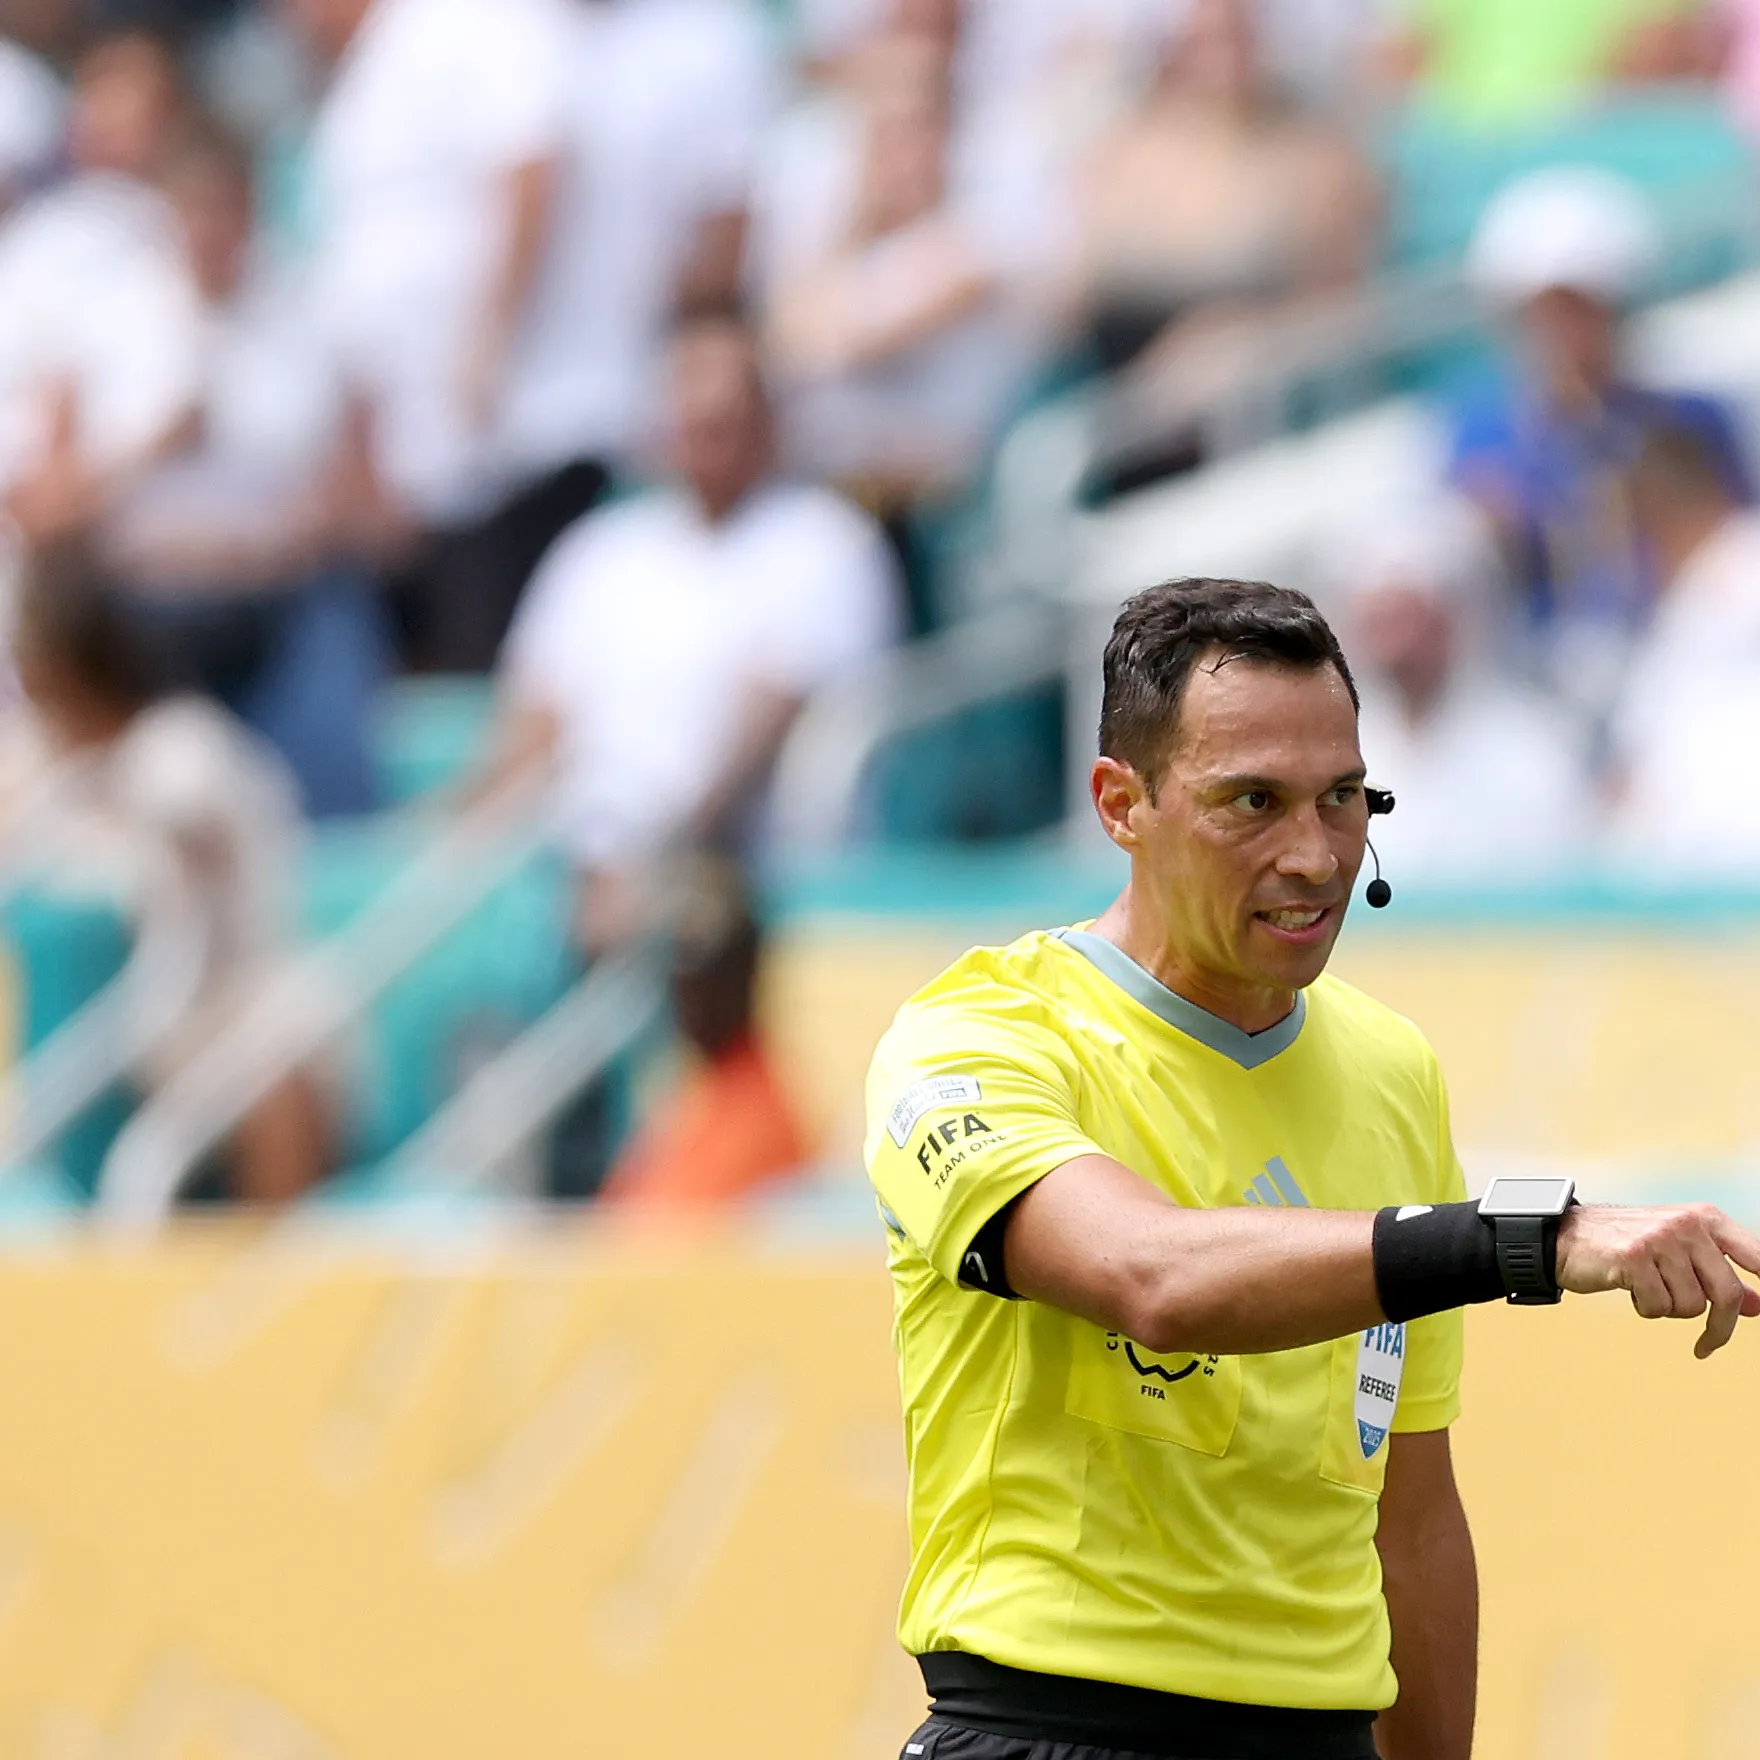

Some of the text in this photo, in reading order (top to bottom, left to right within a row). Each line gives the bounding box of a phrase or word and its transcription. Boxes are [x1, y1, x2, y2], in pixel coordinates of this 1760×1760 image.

[917, 1112, 993, 1176] FIFA
[934, 1151, 967, 1190] TEAM
[1363, 1321, 1404, 1359] FIFA
[1140, 1384, 1166, 1401] FIFA
[1358, 1373, 1397, 1403] REFEREE
